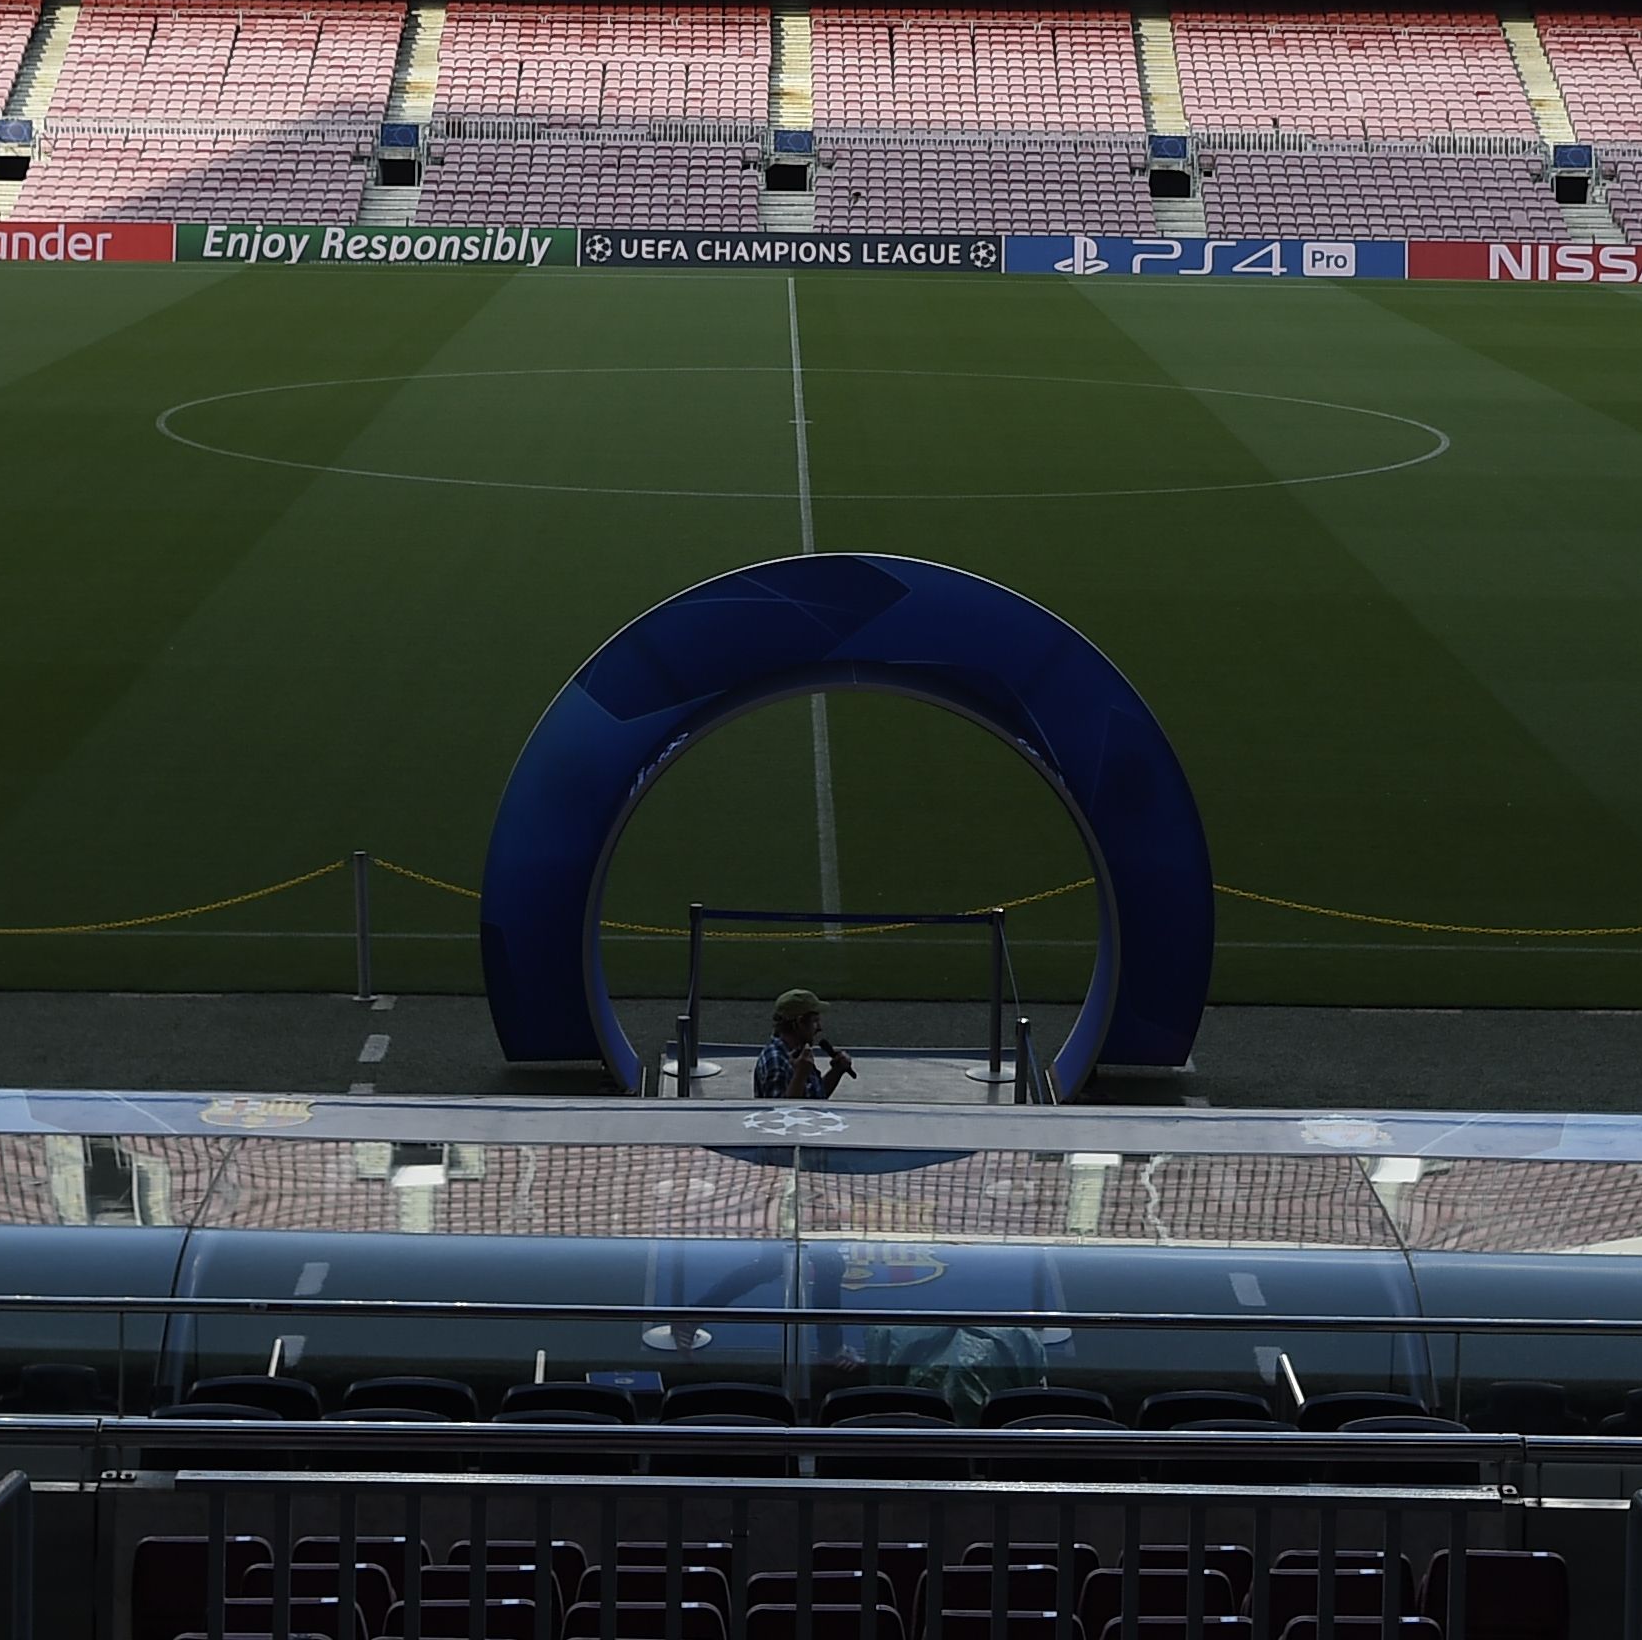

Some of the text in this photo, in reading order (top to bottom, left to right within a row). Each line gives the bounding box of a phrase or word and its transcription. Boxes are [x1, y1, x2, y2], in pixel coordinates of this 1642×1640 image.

[202, 225, 552, 266] Enjoy Responsibly
[621, 239, 961, 266] UEFA CHAMPIONS LEAGUE
[1132, 240, 1349, 276] PS4 Pro
